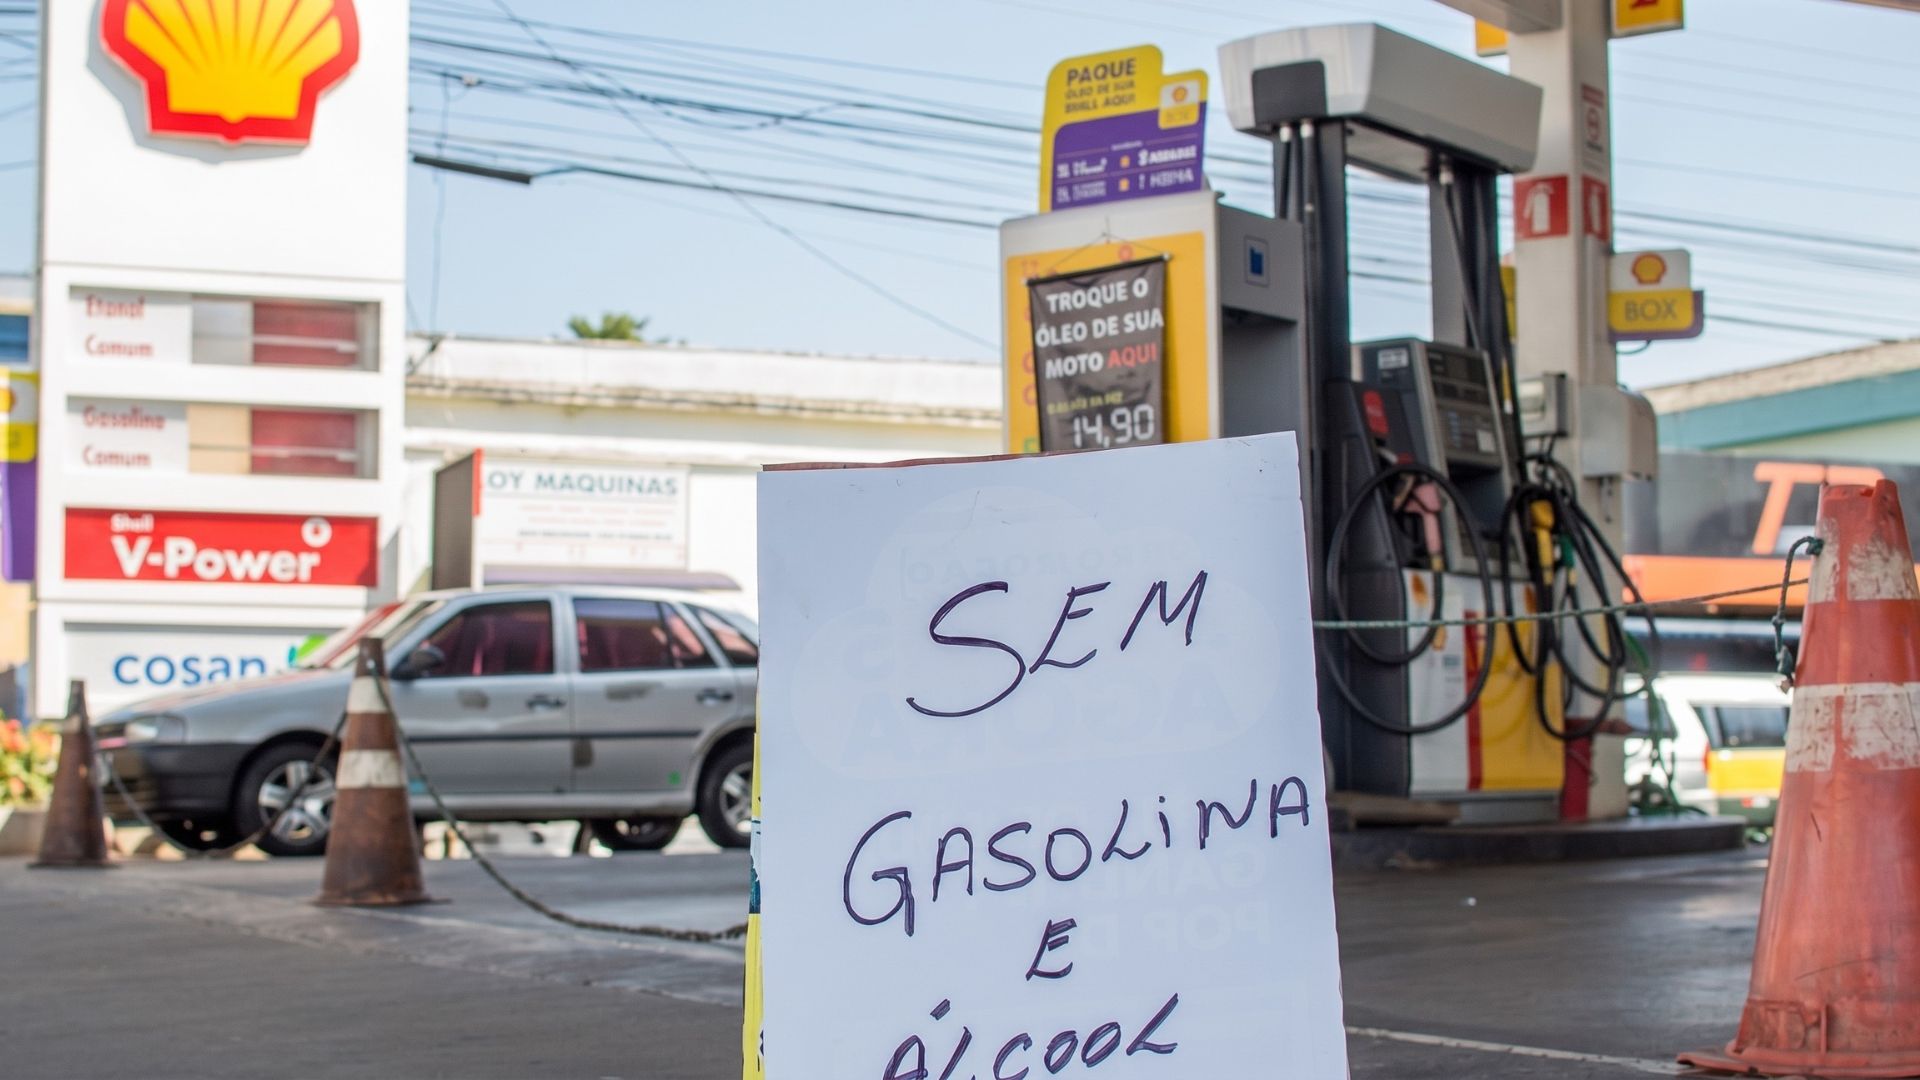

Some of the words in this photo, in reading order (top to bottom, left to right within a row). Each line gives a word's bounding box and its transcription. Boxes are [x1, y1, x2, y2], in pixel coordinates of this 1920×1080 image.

[1046, 282, 1127, 313] TROQUE
[1132, 277, 1149, 298] O
[1624, 298, 1679, 323] BOX
[1035, 321, 1088, 348] ÓLEO
[1092, 315, 1119, 339] DE
[1123, 307, 1164, 334] SUA
[84, 334, 154, 357] Comum
[1045, 353, 1103, 380] MOTO
[1107, 343, 1157, 369] AQUI
[82, 406, 166, 430] Gasolina
[1072, 403, 1155, 449] 14,90
[82, 445, 151, 467] Comum
[534, 472, 678, 496] MAQUINAS
[110, 514, 154, 533] Shell
[110, 535, 321, 583] V-Power
[906, 570, 1208, 717] SEM
[112, 654, 266, 686] cosan
[1025, 918, 1077, 981] E
